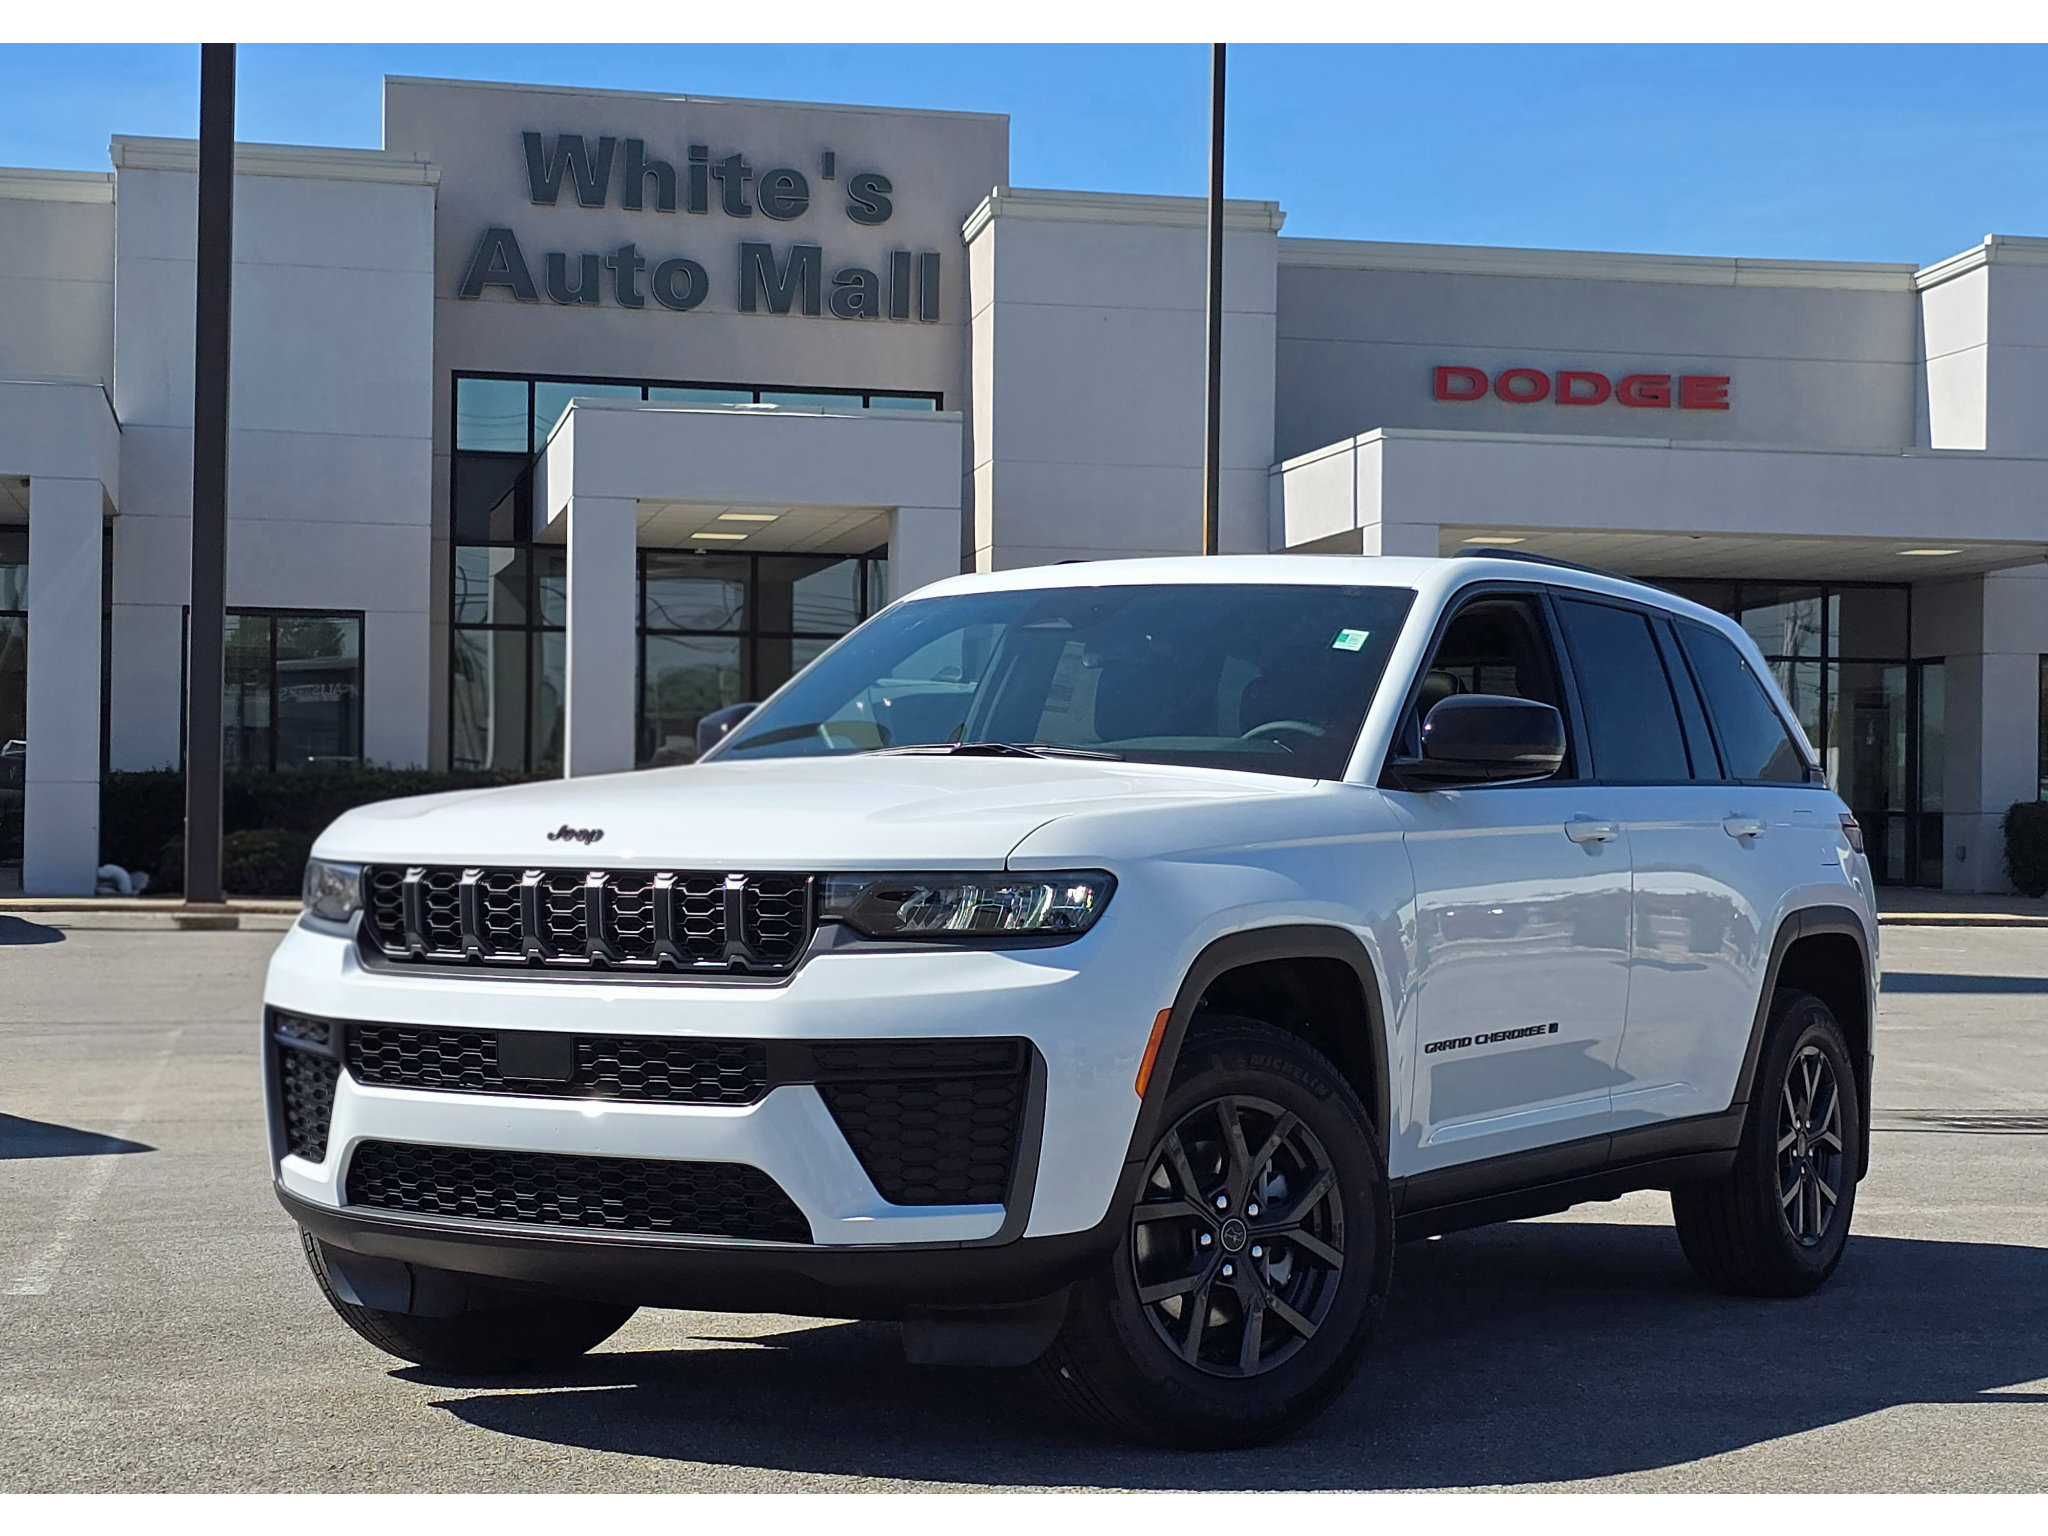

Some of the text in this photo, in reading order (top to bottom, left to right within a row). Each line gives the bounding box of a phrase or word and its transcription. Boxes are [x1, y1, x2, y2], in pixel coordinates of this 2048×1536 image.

[521, 131, 893, 225] White's
[459, 227, 941, 323] Auto Mall
[1432, 366, 1731, 410] DODGE
[547, 824, 605, 846] Jeep
[1424, 1024, 1547, 1054] GRAND CHEROKEE
